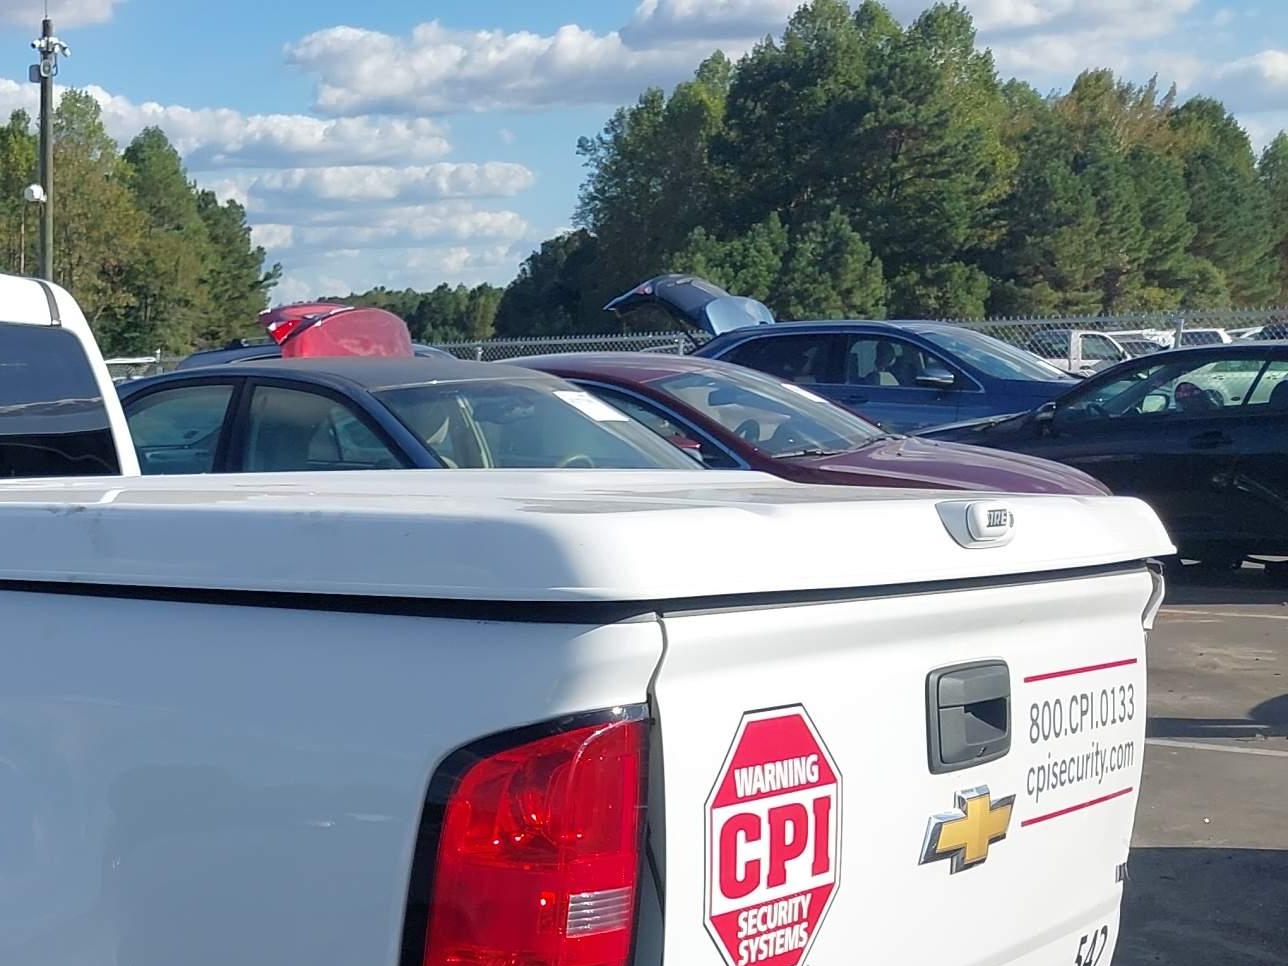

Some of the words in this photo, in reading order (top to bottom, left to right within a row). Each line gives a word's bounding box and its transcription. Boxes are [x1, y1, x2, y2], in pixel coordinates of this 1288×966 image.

[1029, 683, 1135, 744] 800.CPI.0133
[733, 753, 820, 798] WARNING
[1026, 741, 1135, 803] cpisecurity.com
[719, 794, 832, 900] CPI
[737, 891, 813, 940] SECURITY
